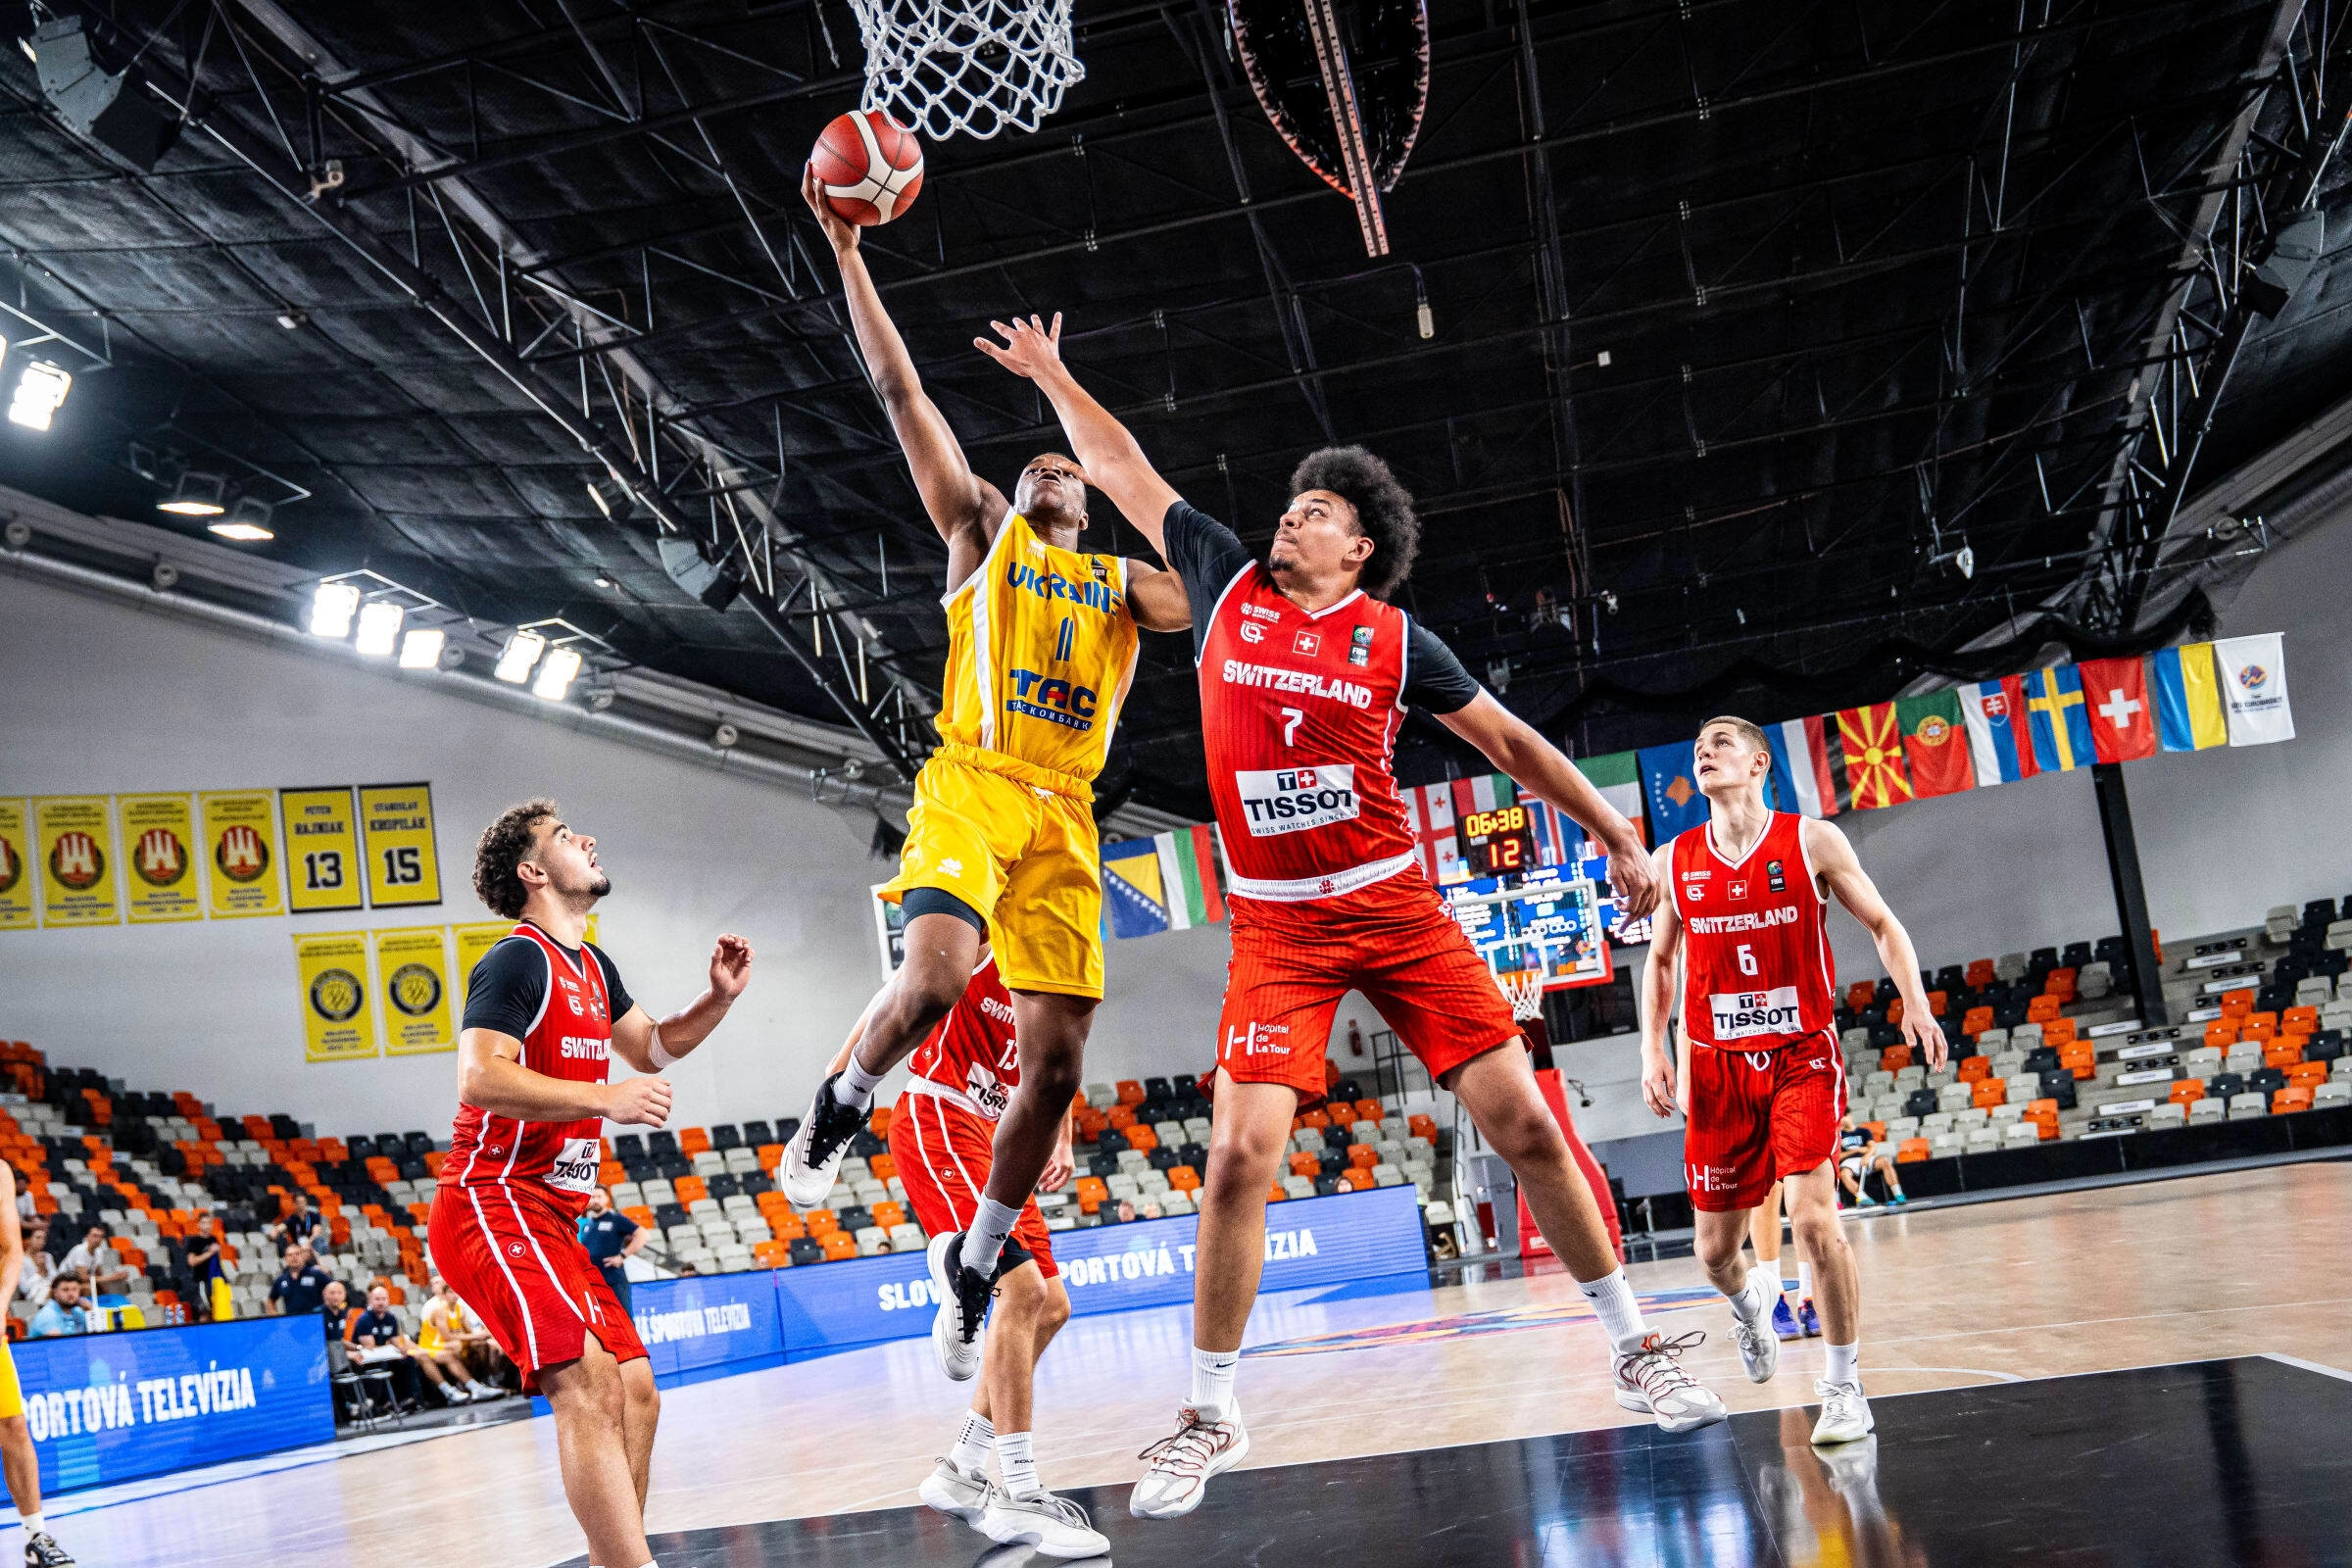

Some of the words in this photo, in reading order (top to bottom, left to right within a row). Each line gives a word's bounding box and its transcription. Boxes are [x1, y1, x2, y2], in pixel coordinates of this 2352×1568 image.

[1006, 561, 1122, 616] UKRAINE
[1253, 606, 1281, 619] SWISS
[1055, 616, 1074, 662] 11
[1222, 659, 1372, 710] SWITZERLAND
[1281, 707, 1303, 748] 7
[1244, 789, 1352, 821] TISSOT
[1465, 807, 1525, 838] 06:38
[383, 847, 421, 884] 15
[1491, 838, 1520, 867] 12
[305, 851, 343, 889] 13
[1689, 906, 1798, 934] SWITZERLAND
[1737, 944, 1759, 976] 6
[1714, 1005, 1798, 1029] TISSOT
[1255, 1034, 1269, 1043] de
[1255, 1044, 1268, 1054] La
[1269, 1044, 1291, 1055] Tour
[1722, 1182, 1739, 1191] Tour
[1056, 1240, 1175, 1287] PORTOVÁ
[137, 1359, 257, 1424] TELEVÍZIA
